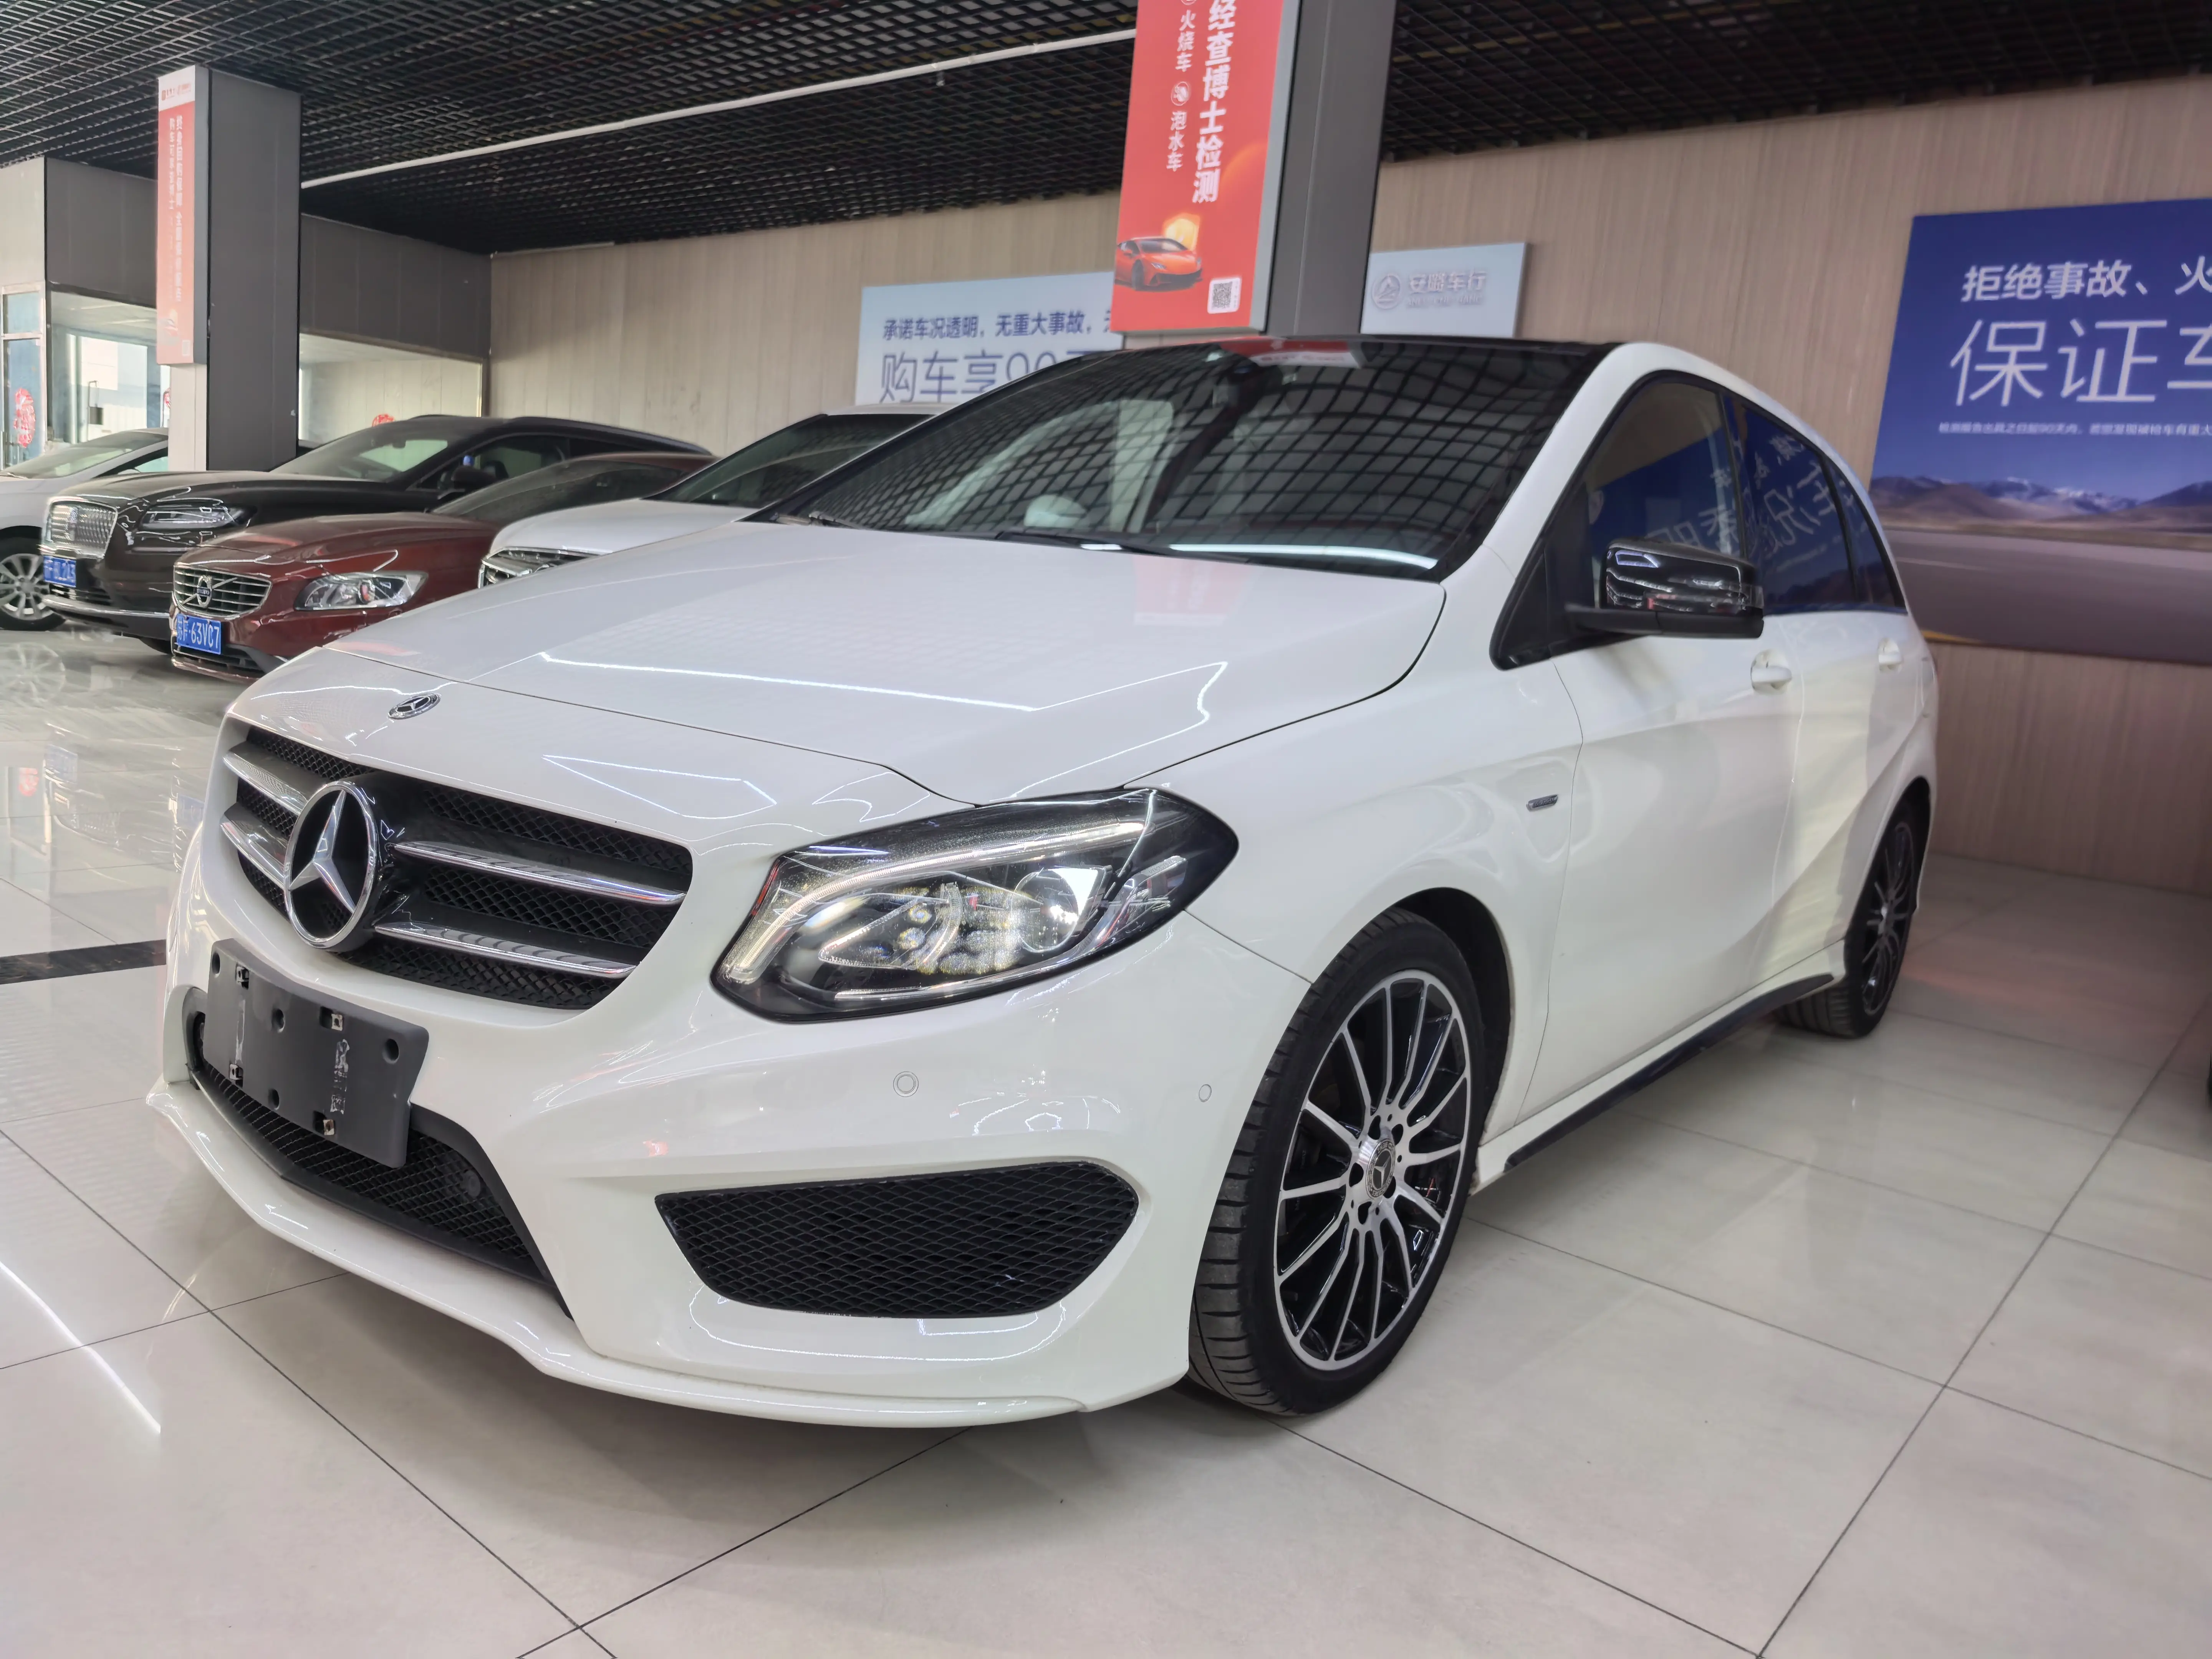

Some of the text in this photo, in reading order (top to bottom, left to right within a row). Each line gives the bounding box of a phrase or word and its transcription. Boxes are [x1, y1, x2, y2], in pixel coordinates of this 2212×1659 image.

[1166, 10, 1196, 172] 火烧车 泡水车
[1192, 0, 1236, 203] 经查博士检测
